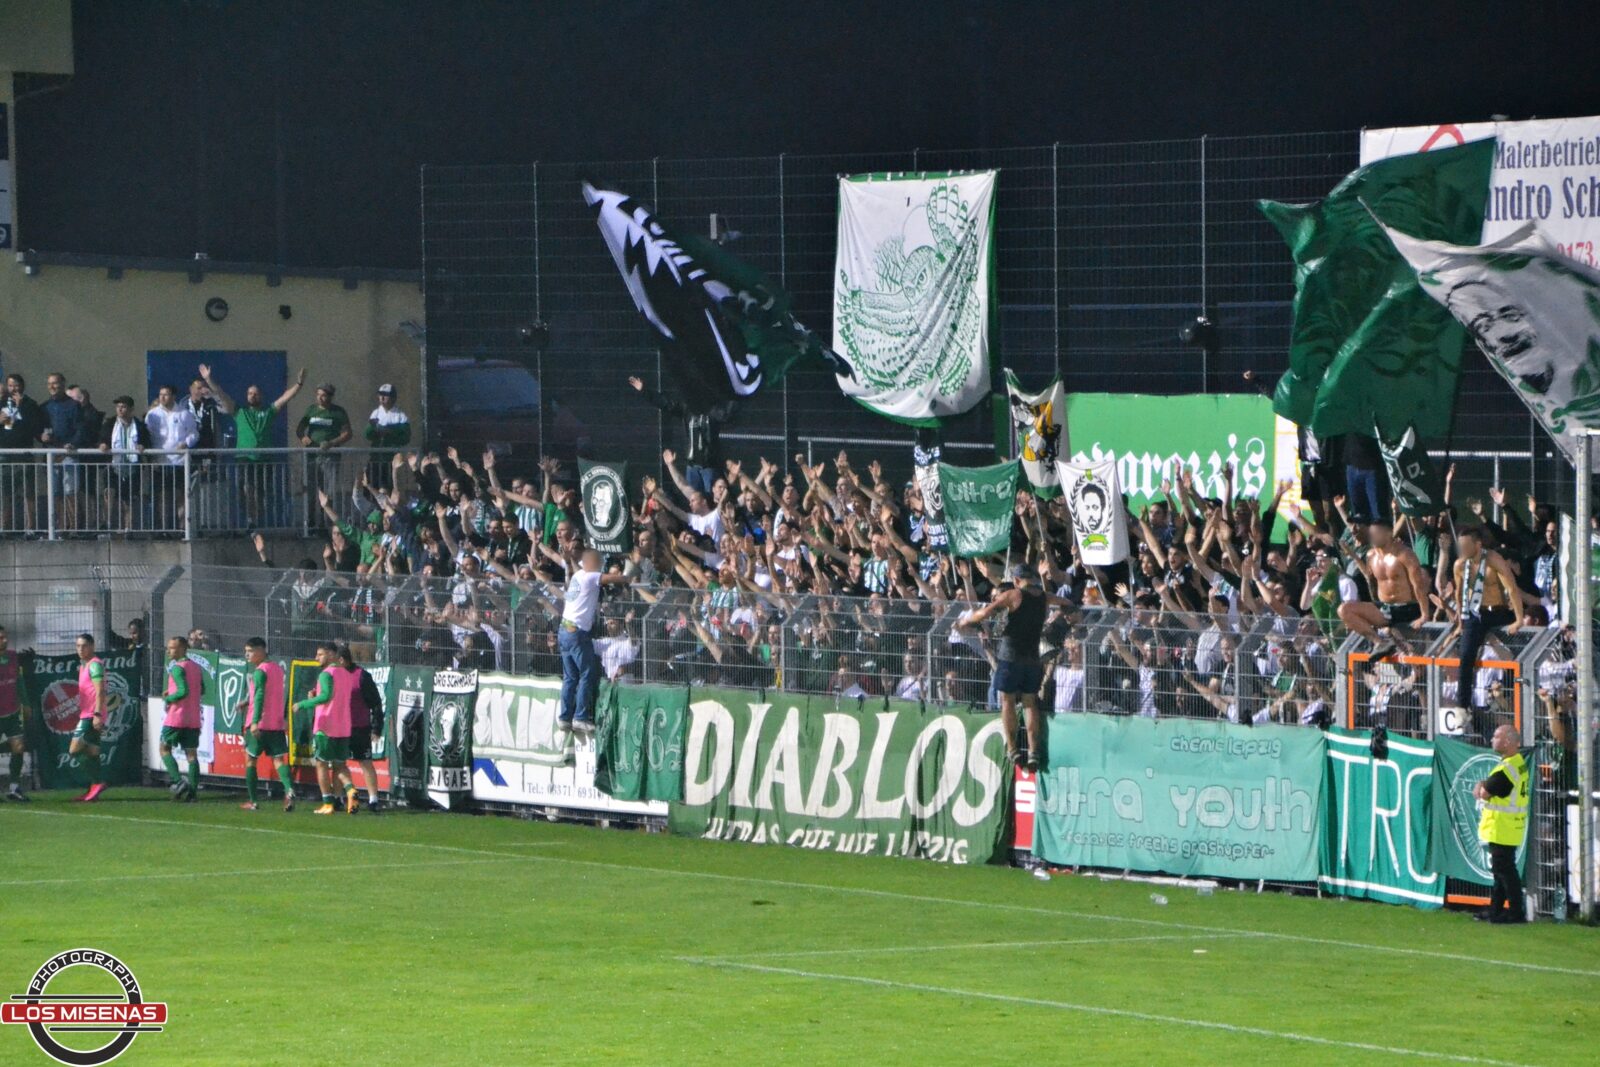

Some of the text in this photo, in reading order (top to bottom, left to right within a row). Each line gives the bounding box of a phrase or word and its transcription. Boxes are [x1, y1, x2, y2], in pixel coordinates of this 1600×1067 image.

[1444, 711, 1457, 732] C
[684, 700, 1007, 827] DIABLOS
[1169, 776, 1312, 832] youth
